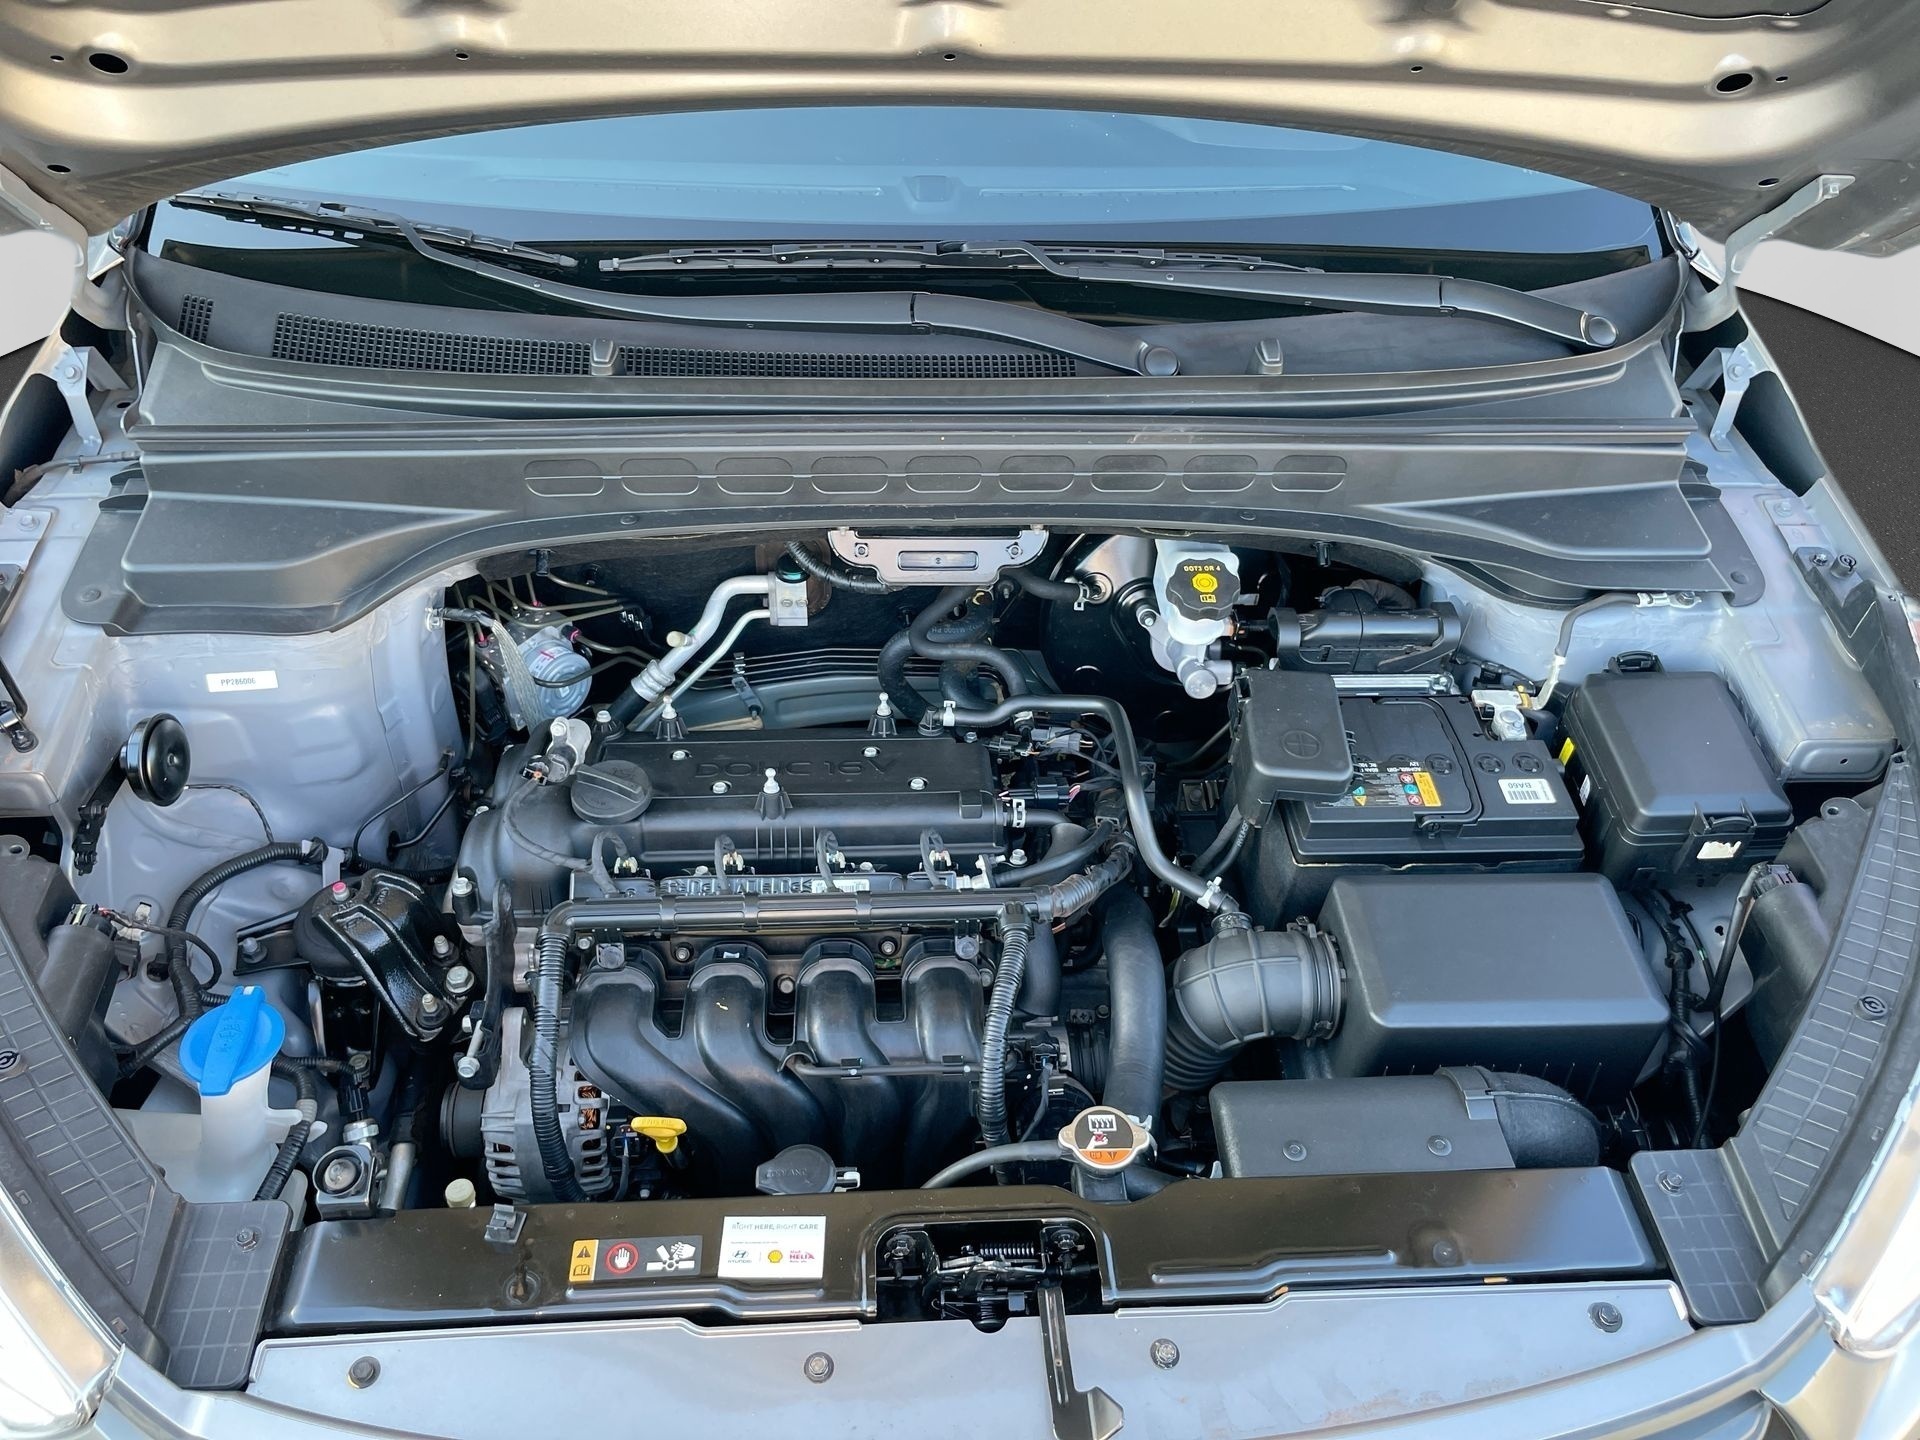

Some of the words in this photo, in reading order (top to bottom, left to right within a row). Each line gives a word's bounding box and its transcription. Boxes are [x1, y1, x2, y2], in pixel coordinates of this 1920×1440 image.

[823, 758, 898, 776] 16V
[731, 1223, 753, 1231] RIGHT
[776, 1223, 797, 1231] RIGHT
[798, 1223, 819, 1231] CARE
